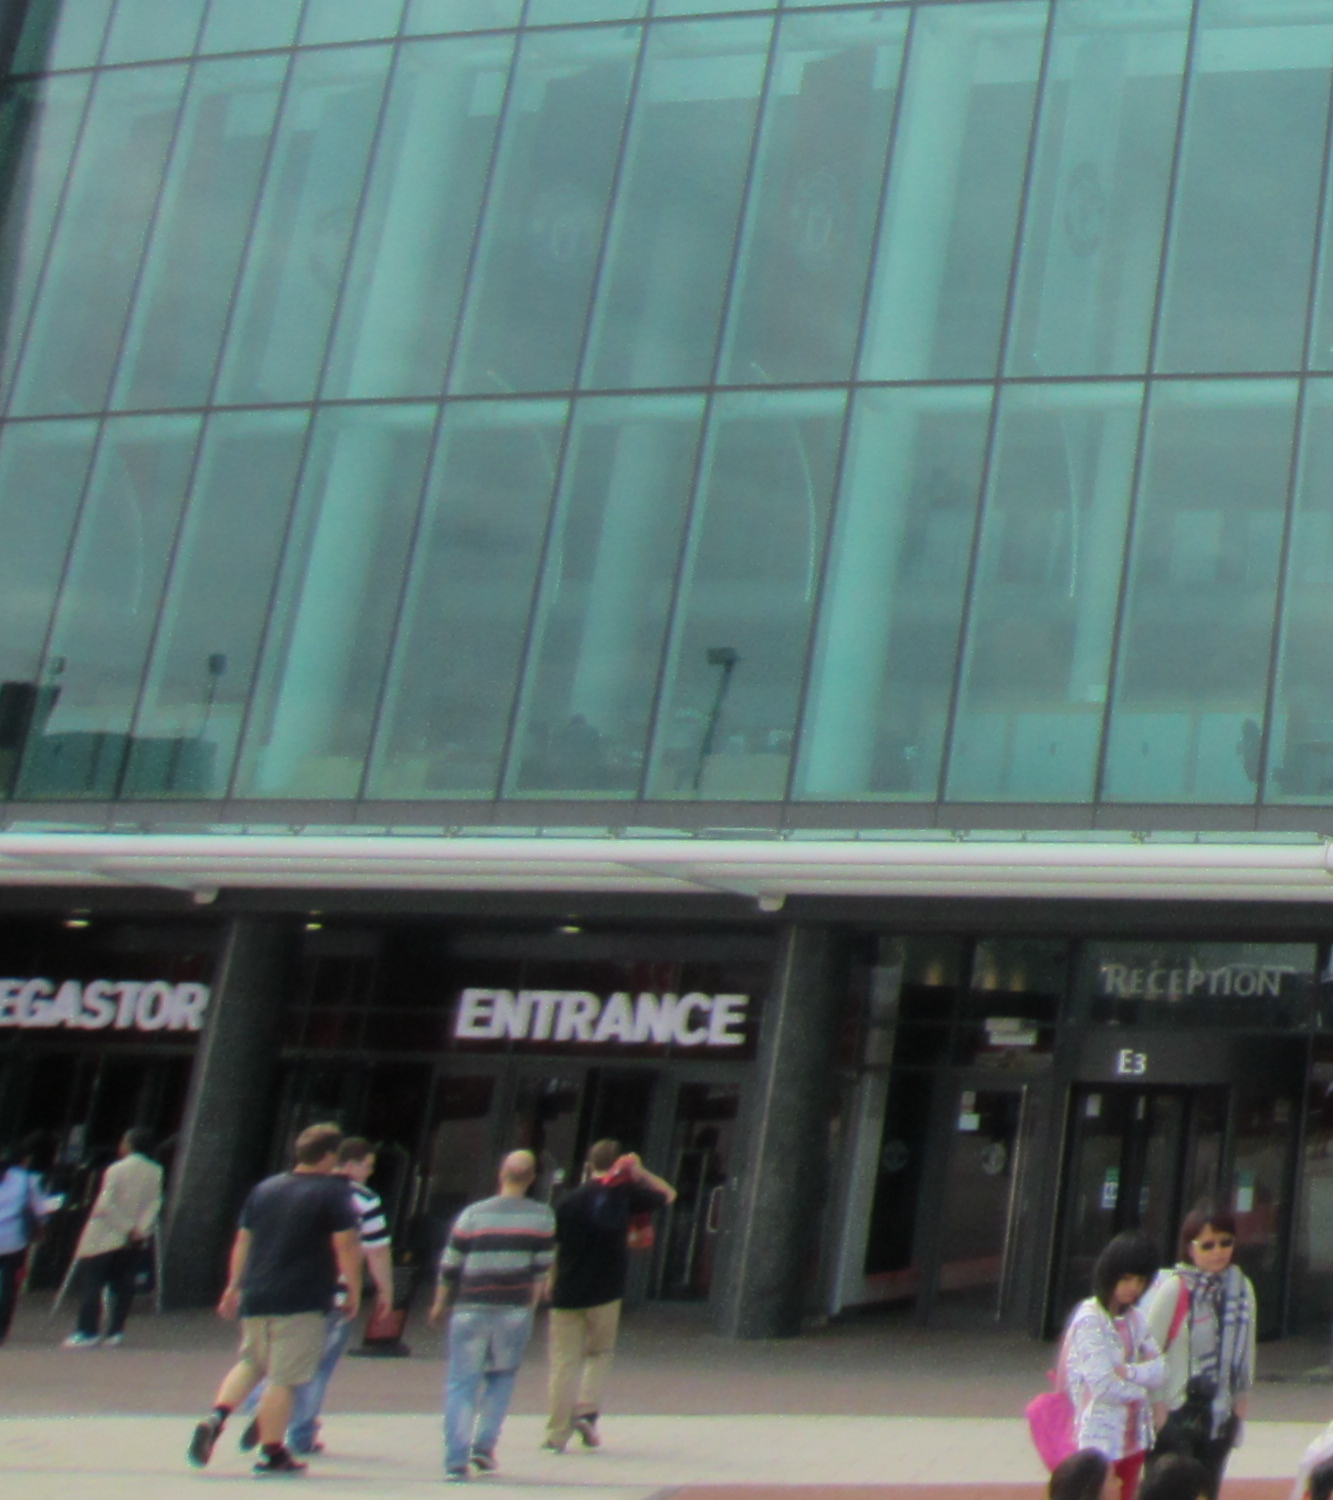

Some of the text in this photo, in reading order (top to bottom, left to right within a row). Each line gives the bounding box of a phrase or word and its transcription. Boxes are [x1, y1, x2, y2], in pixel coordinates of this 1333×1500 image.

[1102, 964, 1280, 996] RECEPTION
[455, 988, 749, 1045] ENTRANCE
[1118, 1049, 1147, 1075] E3
